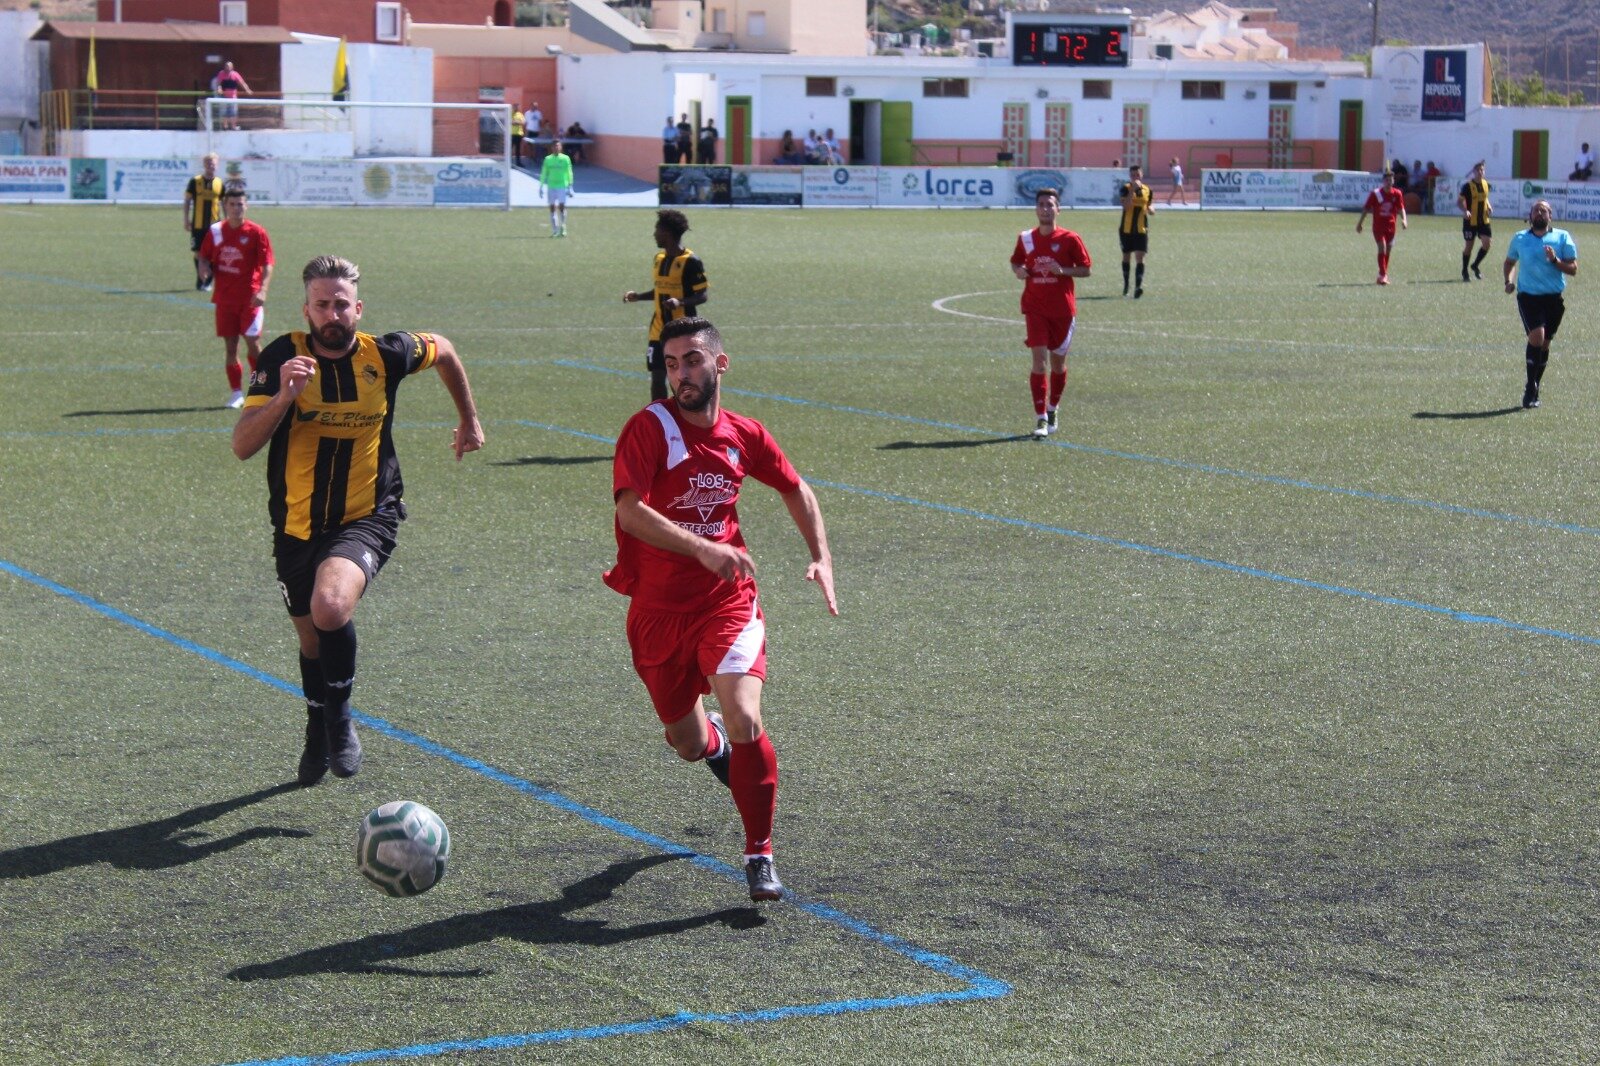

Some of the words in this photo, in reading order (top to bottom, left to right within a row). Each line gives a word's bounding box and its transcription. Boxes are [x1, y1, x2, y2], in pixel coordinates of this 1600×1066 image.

[1030, 31, 1037, 54] 1
[1059, 35, 1089, 60] 72
[1106, 30, 1122, 56] 2
[1435, 56, 1456, 82] RL
[1425, 84, 1462, 96] REPUESTOS
[437, 163, 503, 181] Sevilla
[1205, 171, 1242, 185] AMG
[925, 169, 993, 196] lorca
[321, 411, 337, 421] El
[697, 473, 724, 488] LOS
